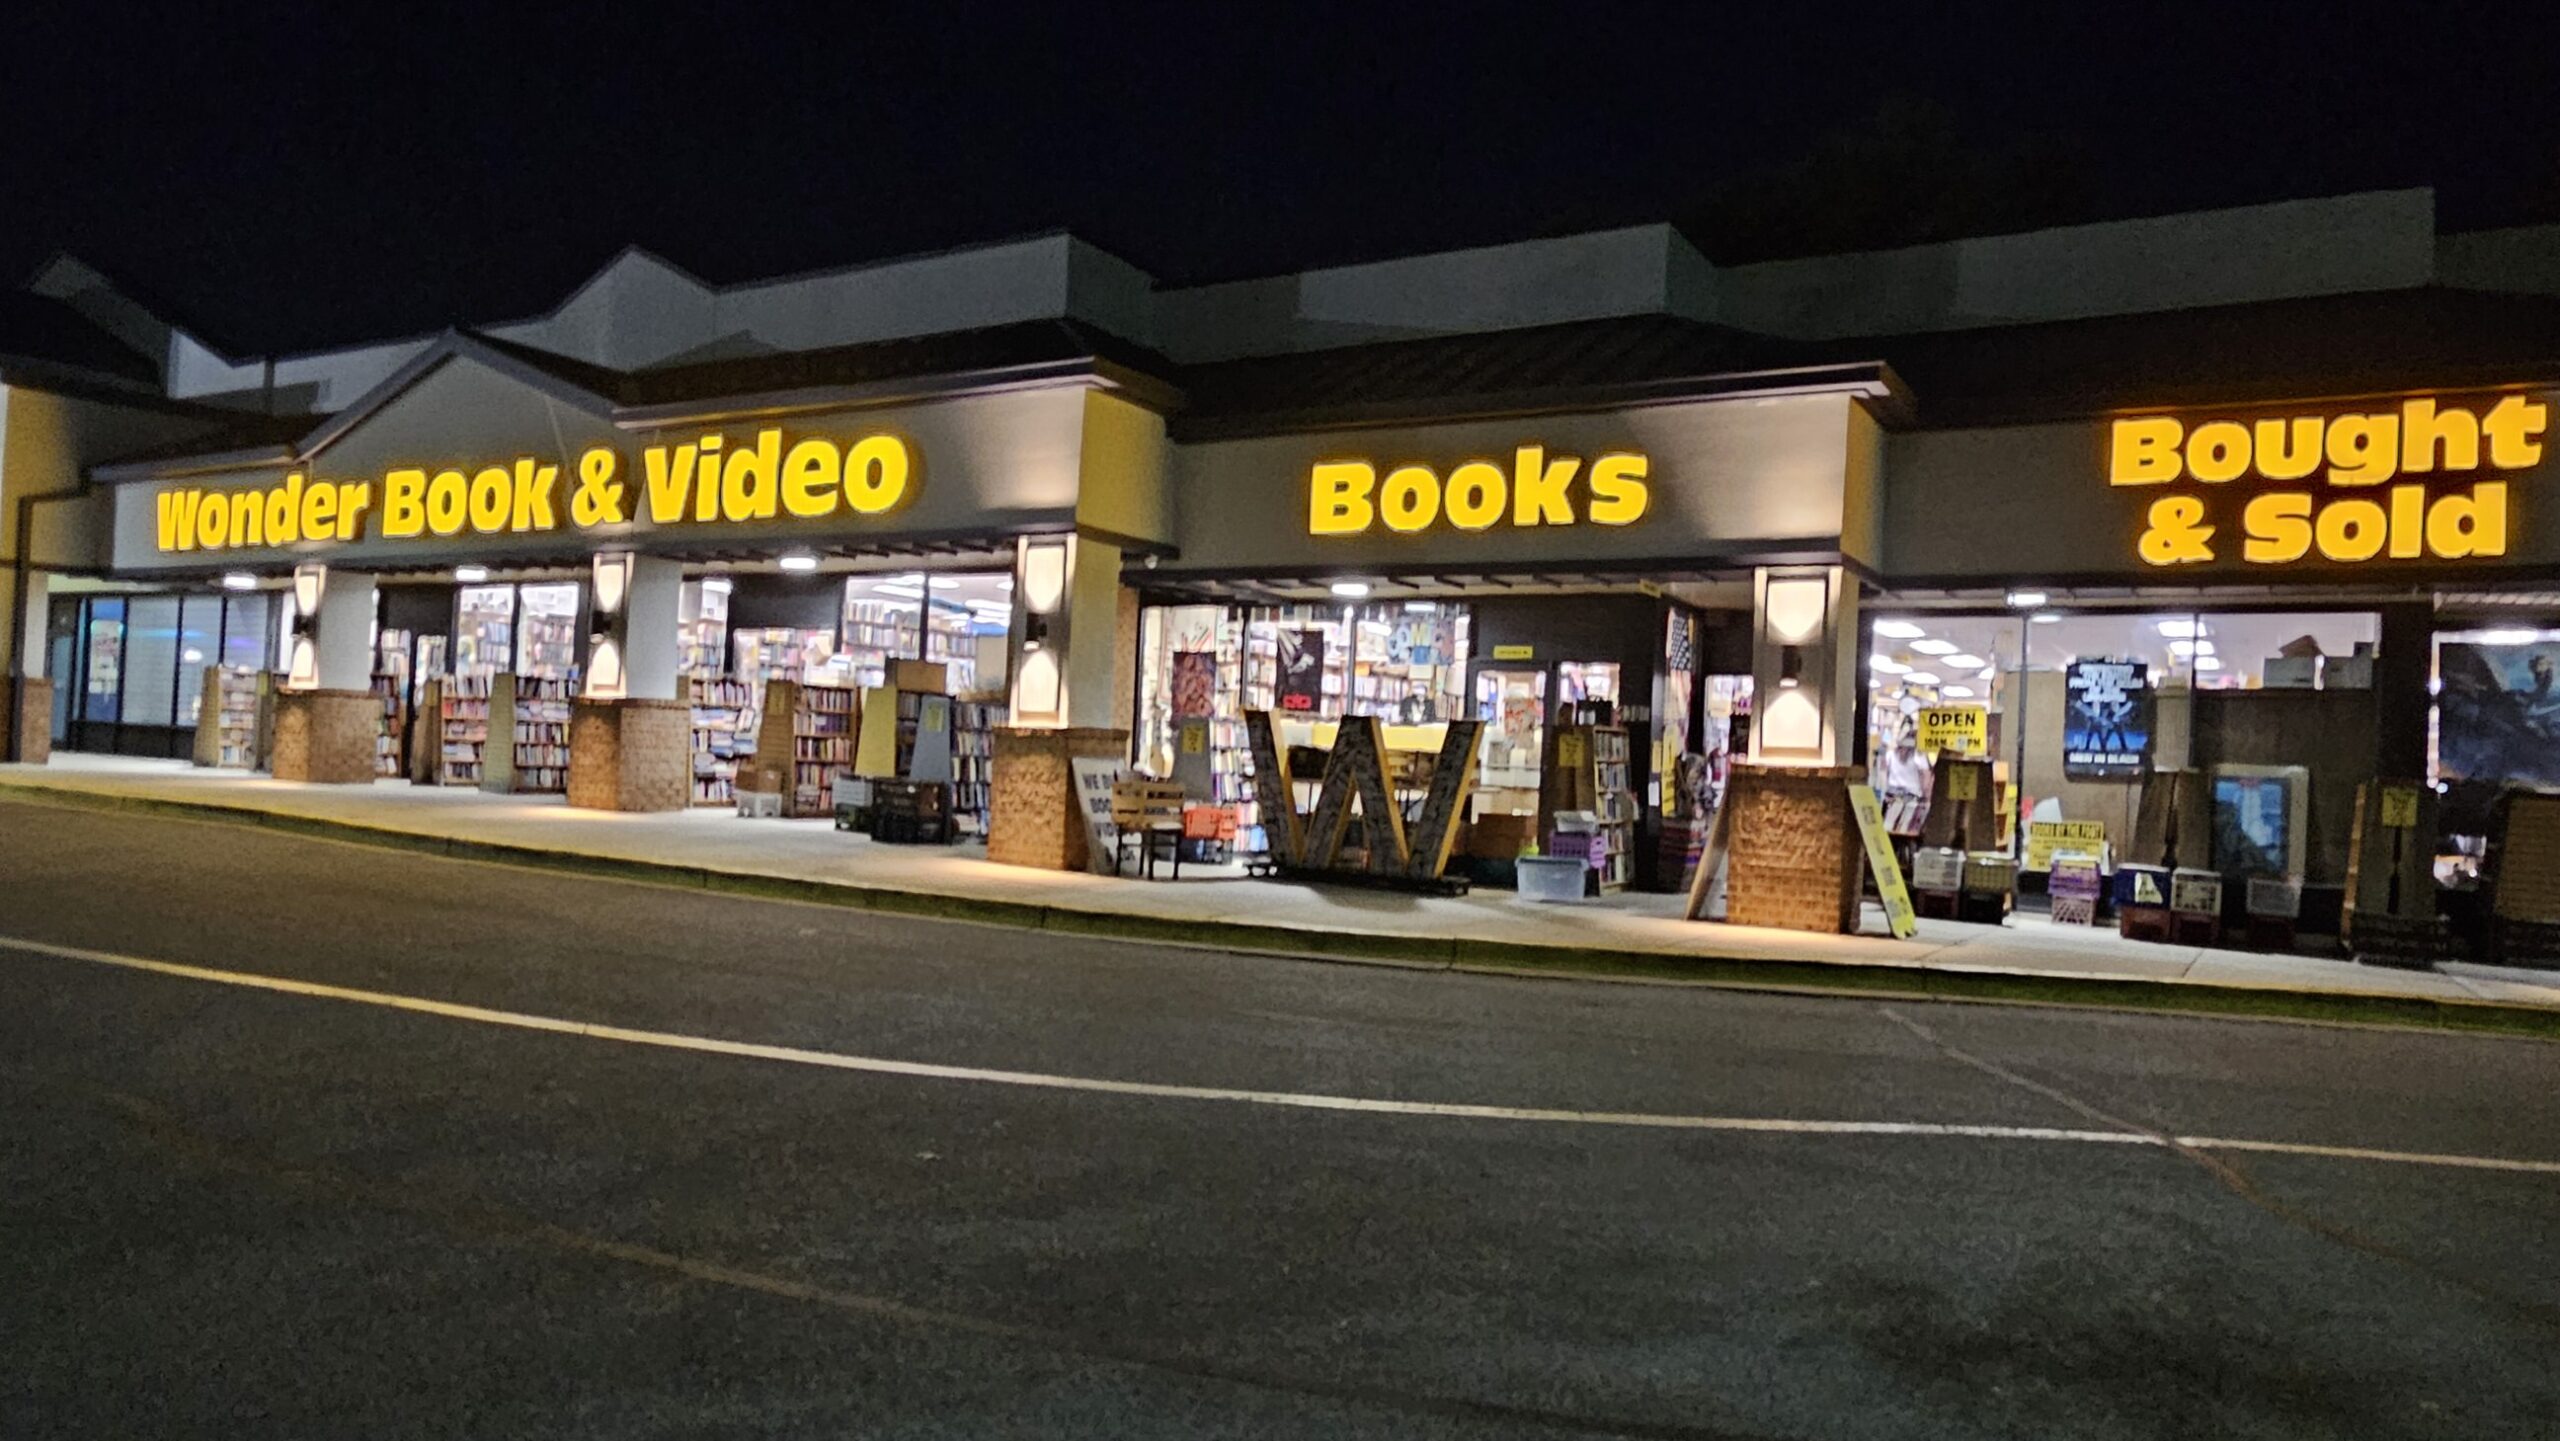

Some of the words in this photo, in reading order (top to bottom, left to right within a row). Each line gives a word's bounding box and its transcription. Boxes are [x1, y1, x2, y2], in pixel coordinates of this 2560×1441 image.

[2110, 394, 2549, 487] Bought
[155, 472, 370, 553] Wonder
[382, 456, 559, 538] Book
[570, 446, 625, 528] &
[643, 427, 910, 525] Video
[1309, 444, 1649, 535] Books
[2137, 494, 2216, 566] &
[2243, 481, 2509, 563] Sold
[1928, 712, 1976, 727] OPEN
